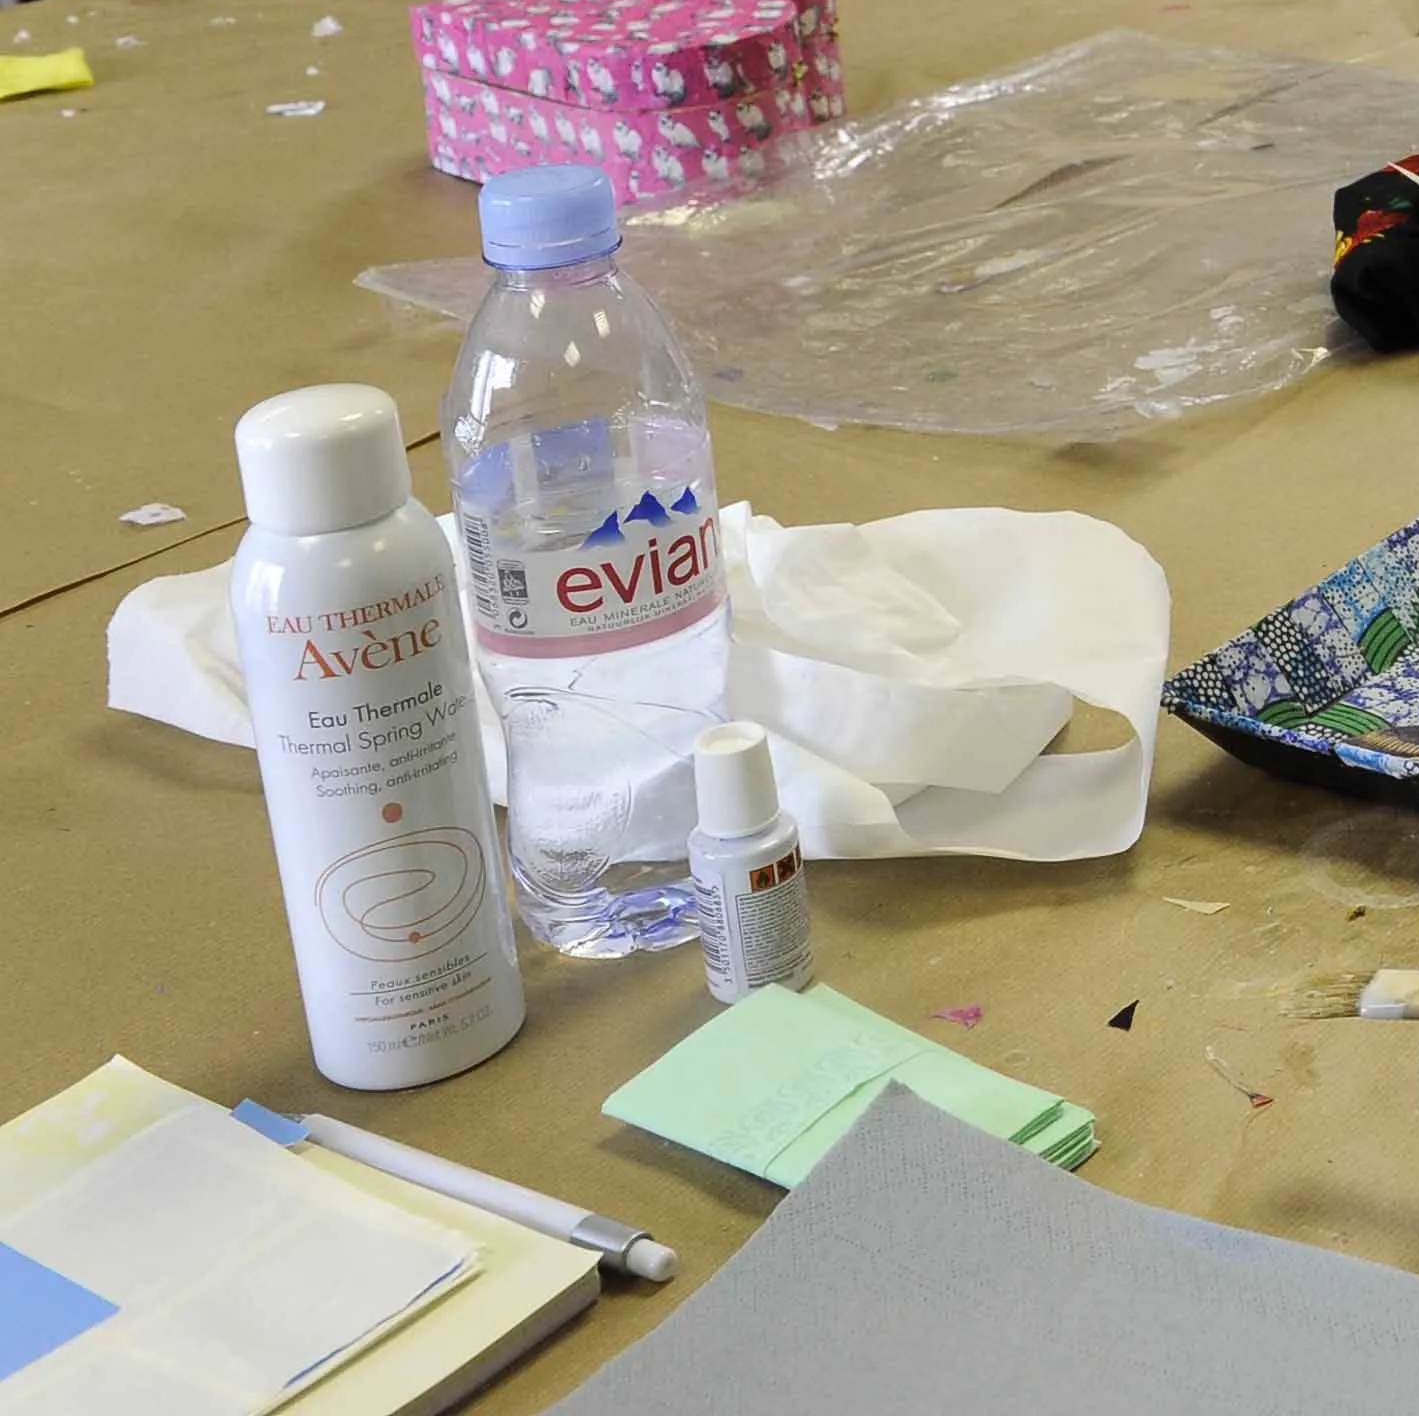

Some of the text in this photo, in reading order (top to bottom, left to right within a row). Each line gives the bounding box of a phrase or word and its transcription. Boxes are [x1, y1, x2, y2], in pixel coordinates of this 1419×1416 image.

[556, 517, 719, 614] evian
[267, 573, 449, 634] EAU THERMALE
[570, 616, 597, 627] EAU
[603, 596, 672, 621] MINERALE
[293, 618, 443, 680] Avène
[308, 682, 443, 729] Eau Thermale
[278, 734, 351, 756] Thermal
[359, 721, 423, 753] Spring
[370, 954, 471, 991] Peaux sensibles
[375, 995, 394, 1007] For
[399, 983, 448, 1003] sensitive
[409, 1014, 451, 1031] PARIS
